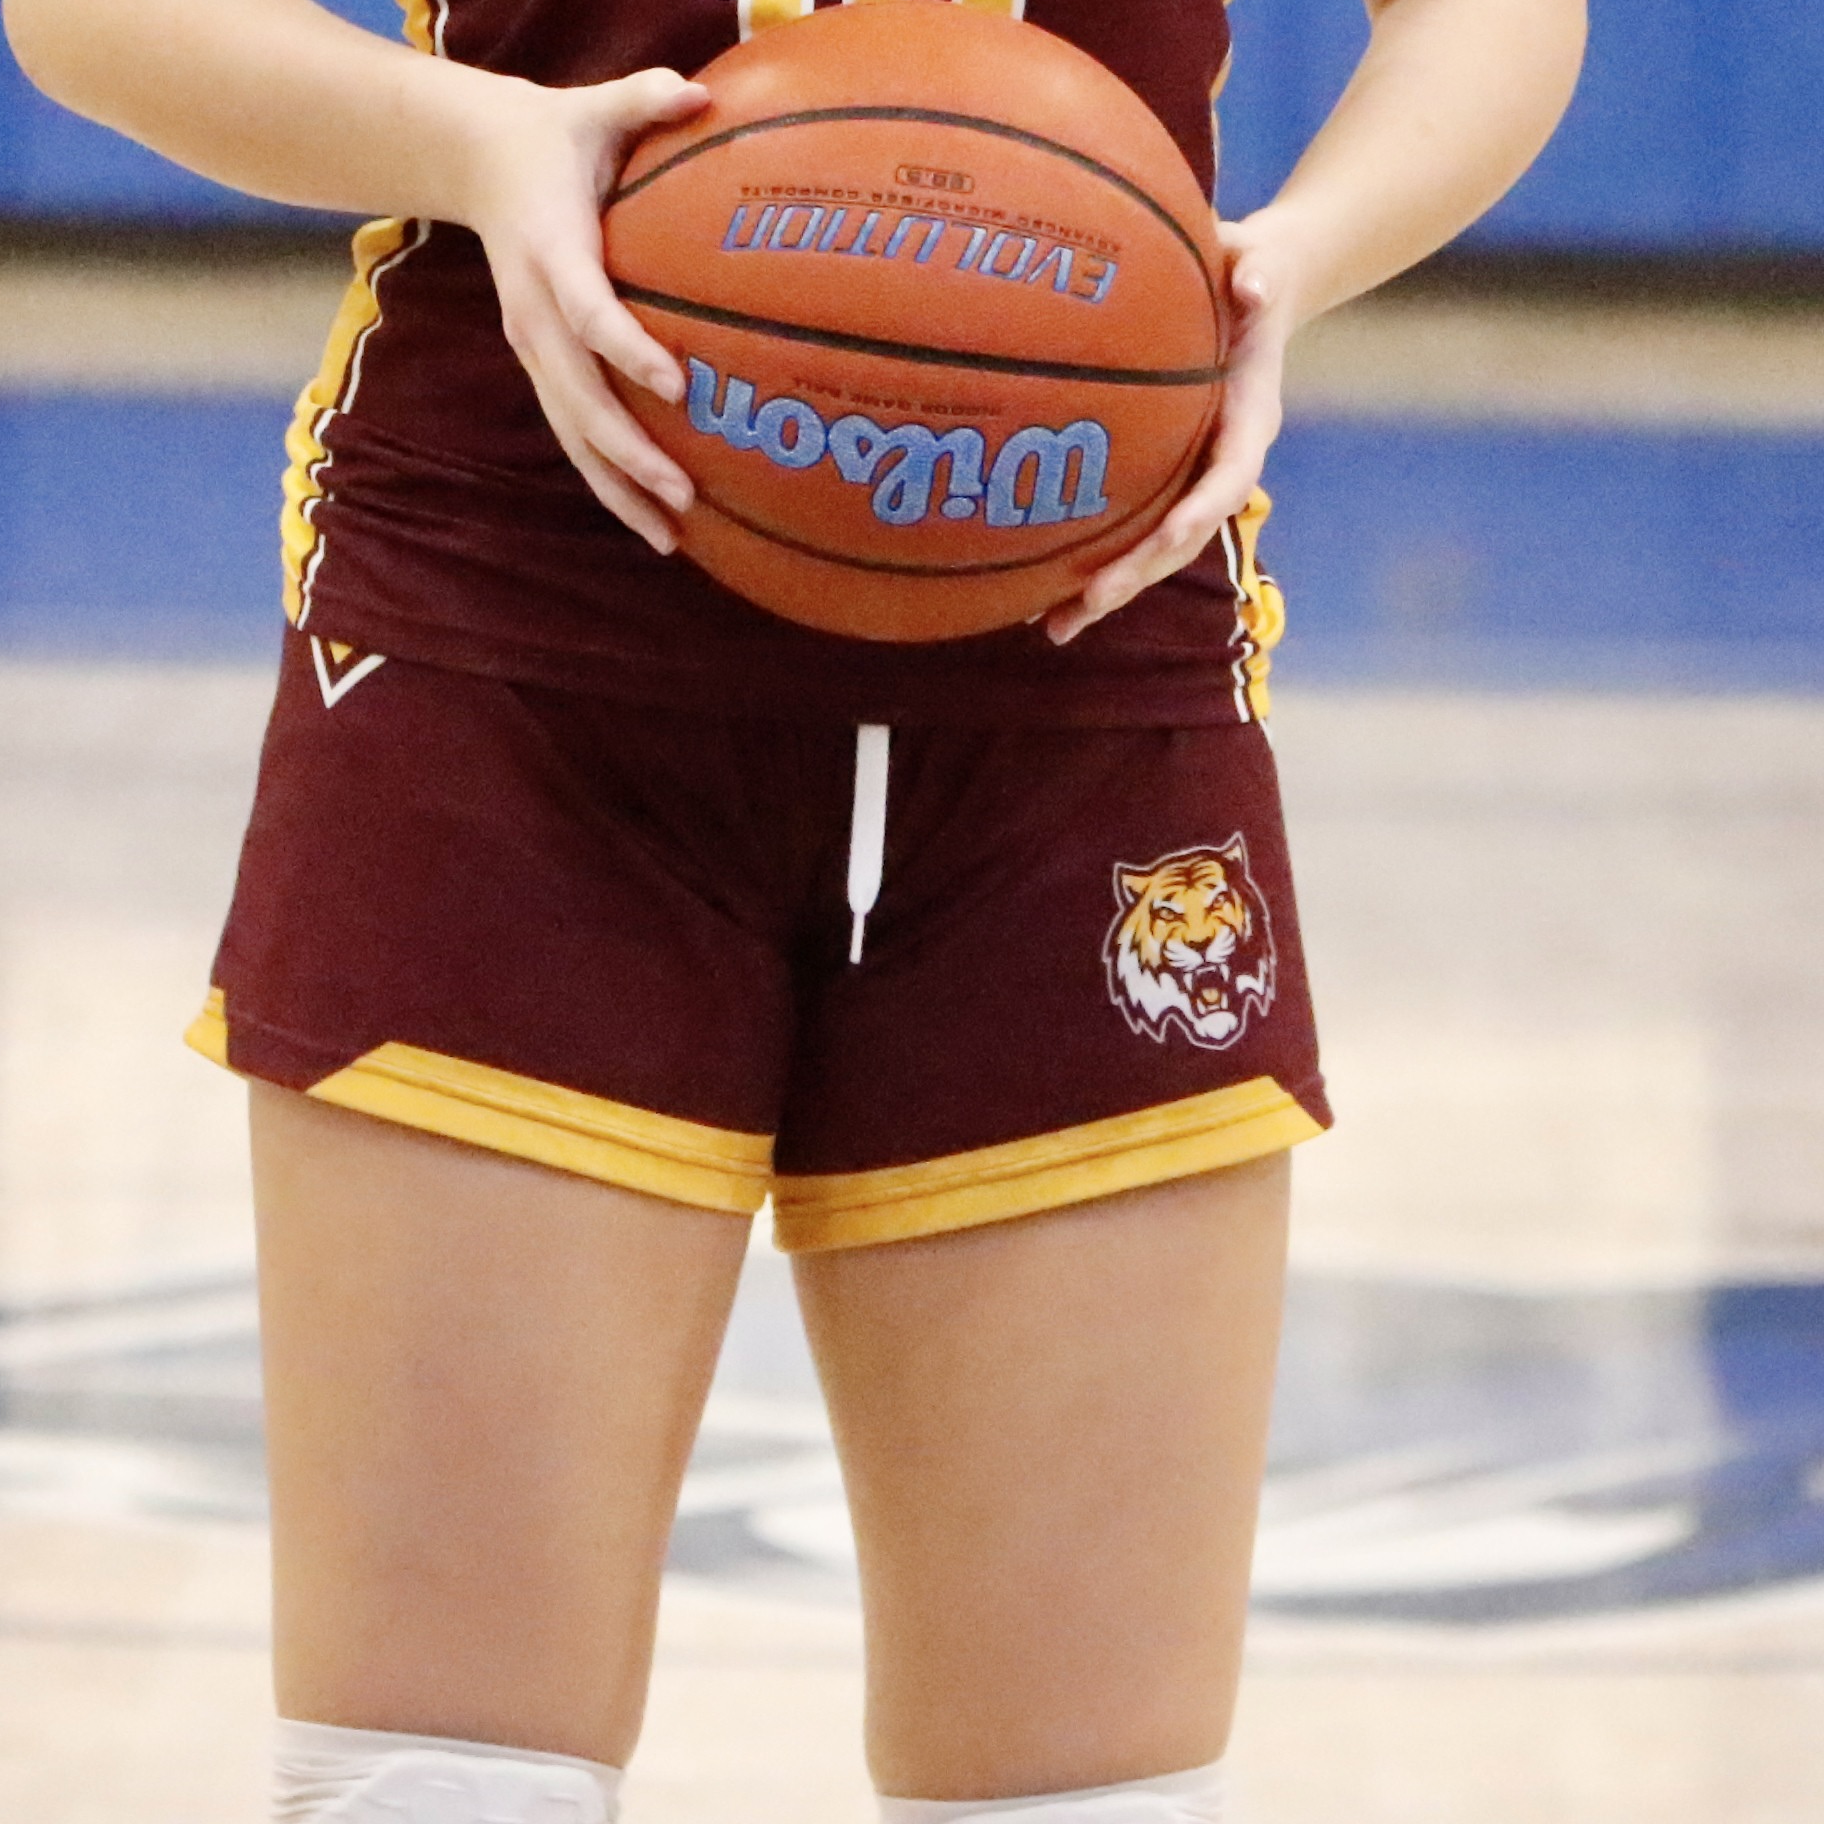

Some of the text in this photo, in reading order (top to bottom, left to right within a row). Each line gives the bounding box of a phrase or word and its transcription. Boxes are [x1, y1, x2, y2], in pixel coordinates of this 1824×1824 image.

[720, 203, 1119, 305] EVOLUTION
[739, 185, 1122, 253] ADVANCED MICROFIBER COMPOSITE
[849, 383, 913, 411] GAME
[686, 355, 1111, 528] Wilson
